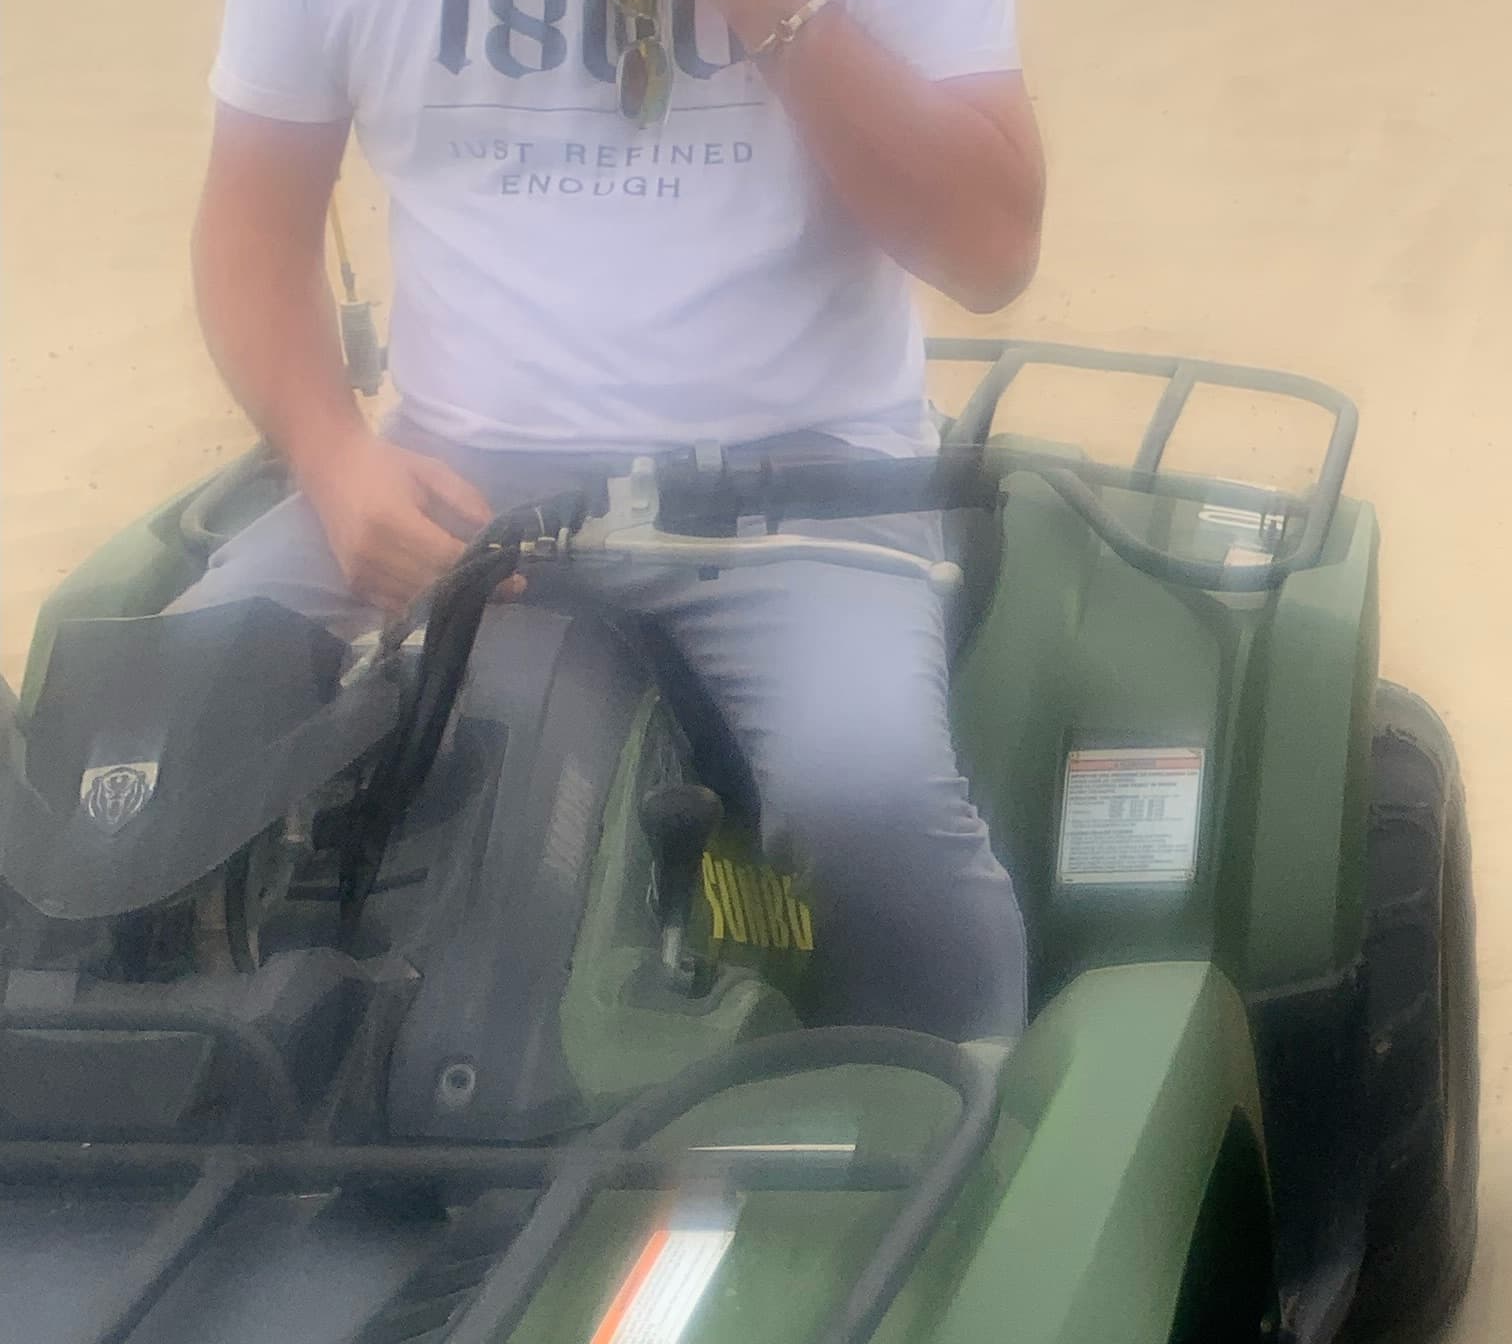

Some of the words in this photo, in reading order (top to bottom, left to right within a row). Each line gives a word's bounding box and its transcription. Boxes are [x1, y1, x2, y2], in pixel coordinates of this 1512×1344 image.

[447, 138, 535, 164] JUST
[565, 141, 754, 169] REFINED
[501, 172, 681, 199] ENOUGH
